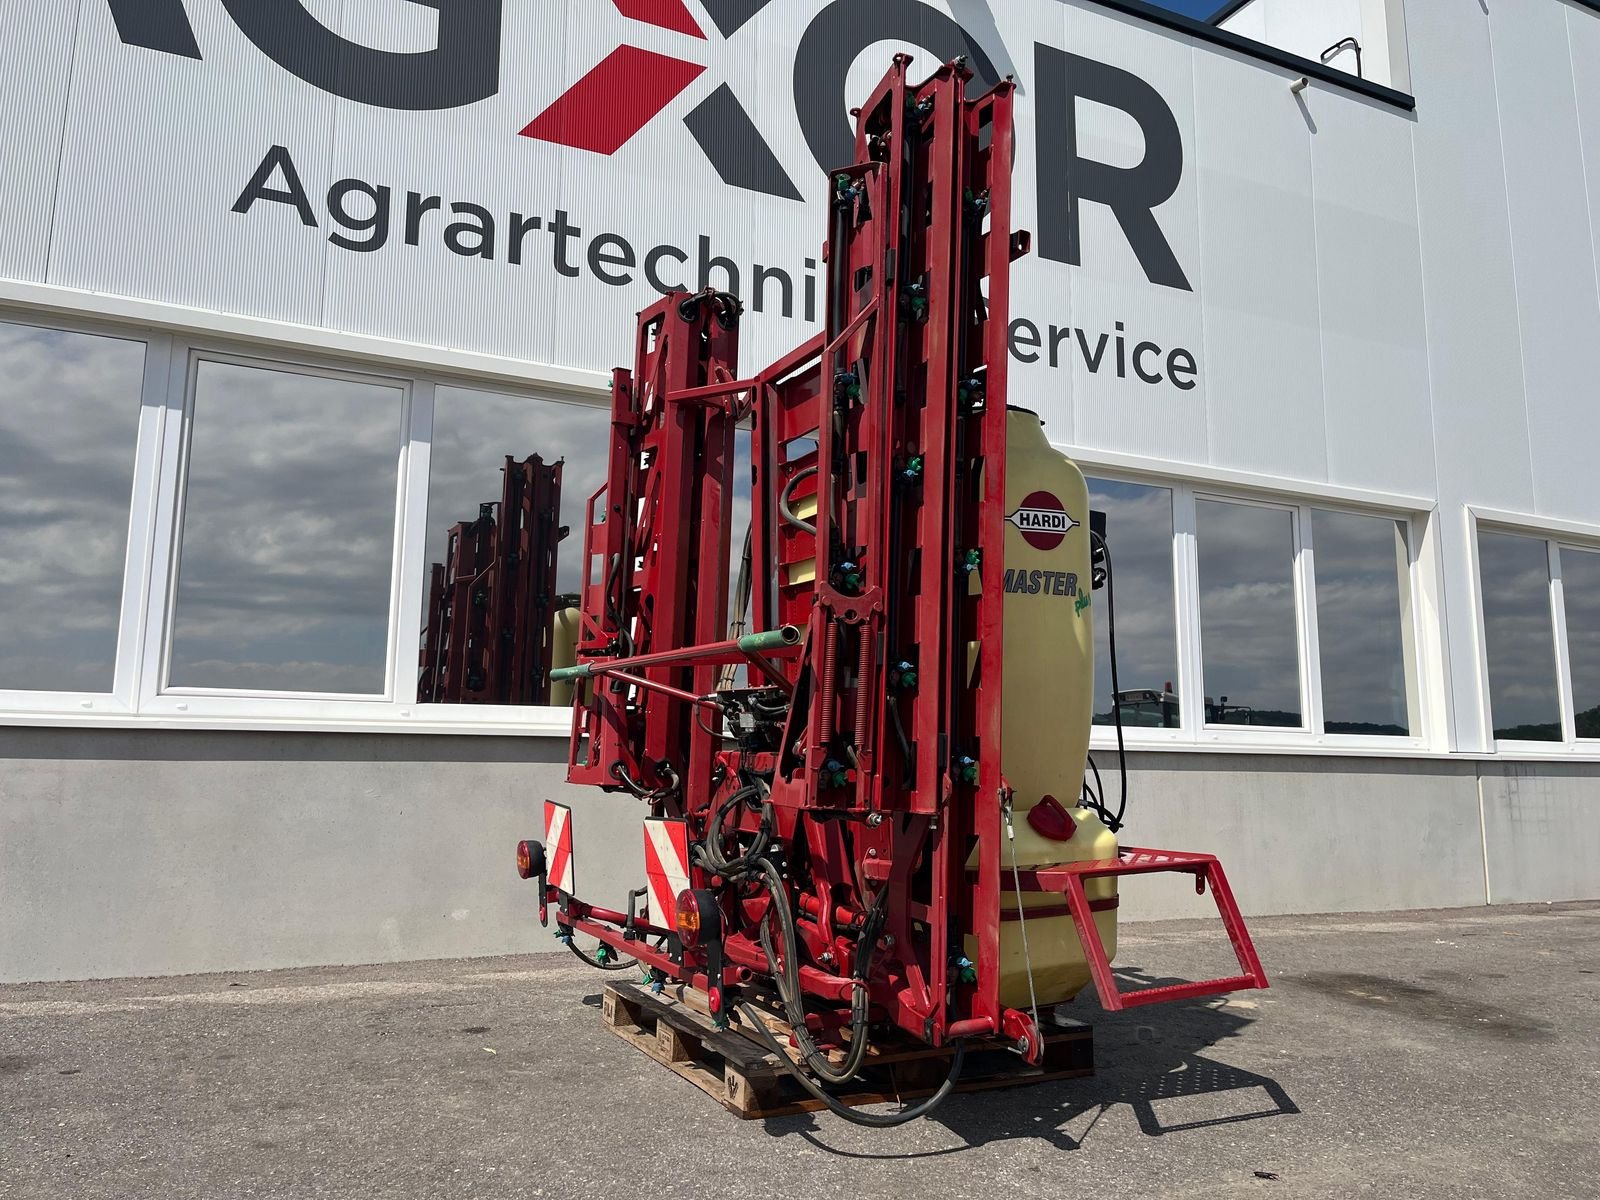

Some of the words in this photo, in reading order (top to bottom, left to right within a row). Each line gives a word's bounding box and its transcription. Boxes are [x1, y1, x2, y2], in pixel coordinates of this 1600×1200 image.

[231, 144, 816, 323] Agrartechni
[1007, 317, 1198, 391] ervice
[1019, 512, 1066, 529] HARDI
